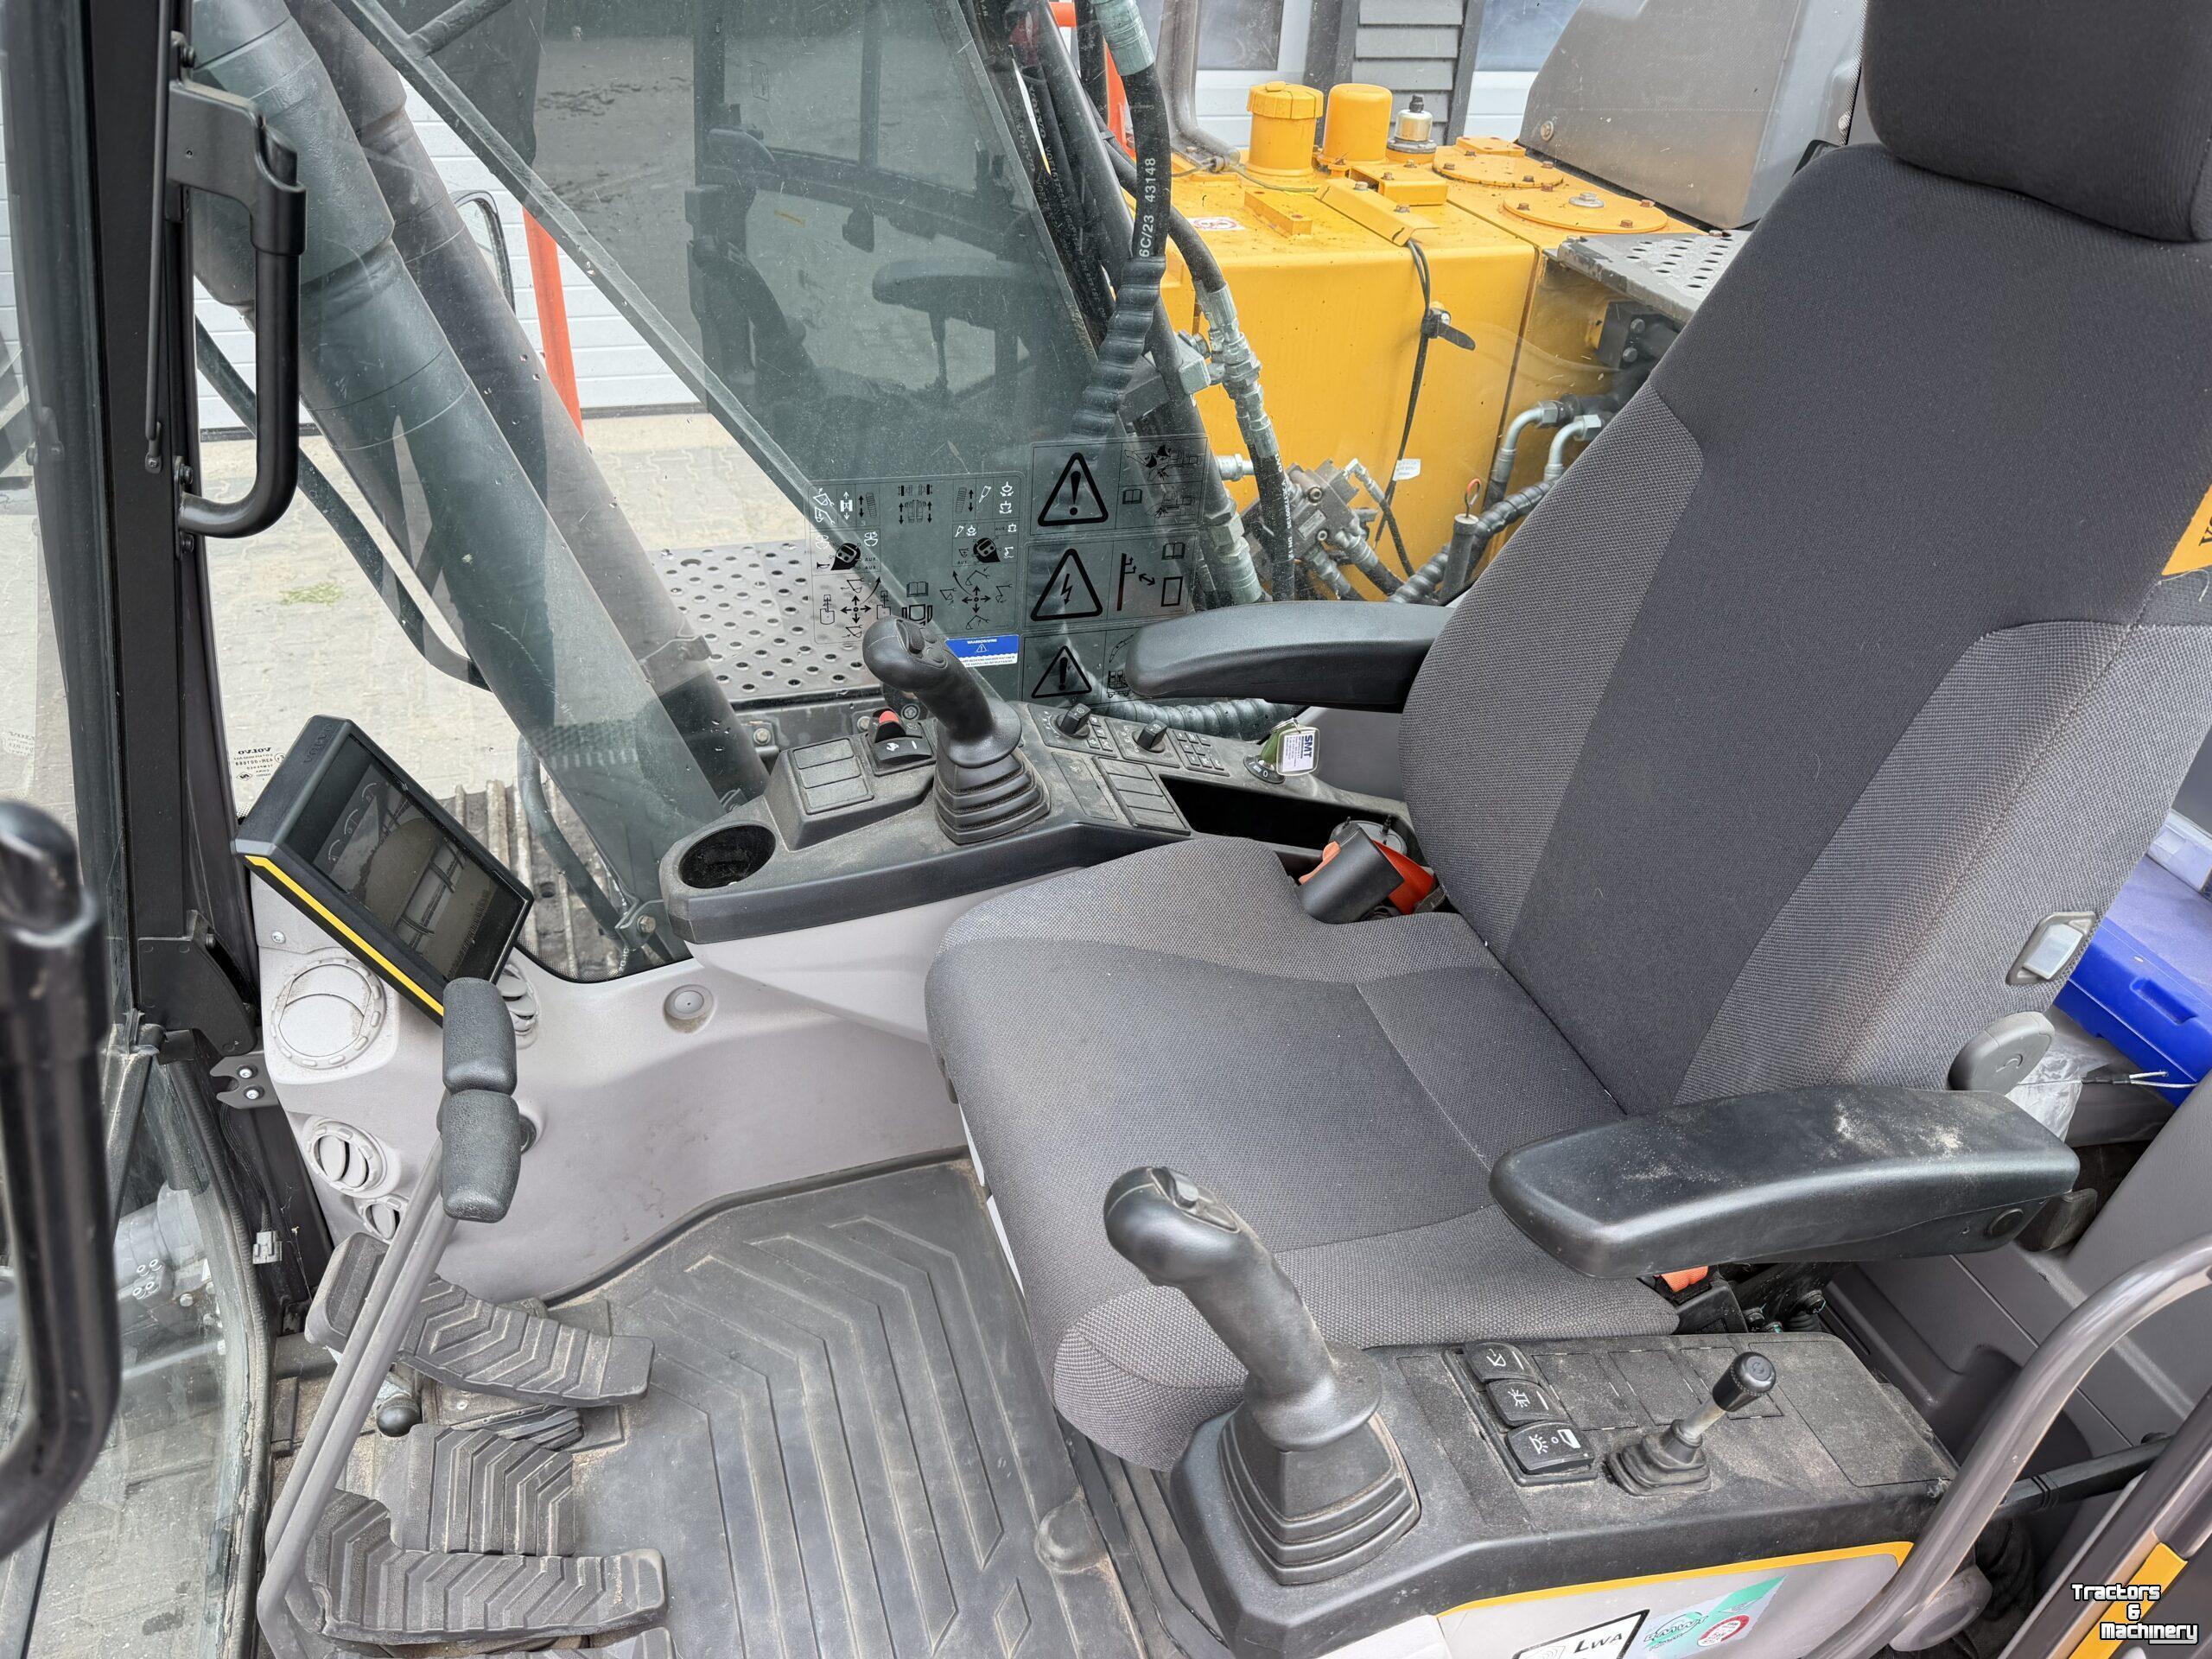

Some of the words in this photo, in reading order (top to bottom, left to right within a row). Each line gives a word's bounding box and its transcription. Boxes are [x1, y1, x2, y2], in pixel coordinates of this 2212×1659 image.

[1144, 157, 1157, 203] 43148
[1139, 214, 1155, 257] 6C/23
[1304, 734, 1313, 757] SMT
